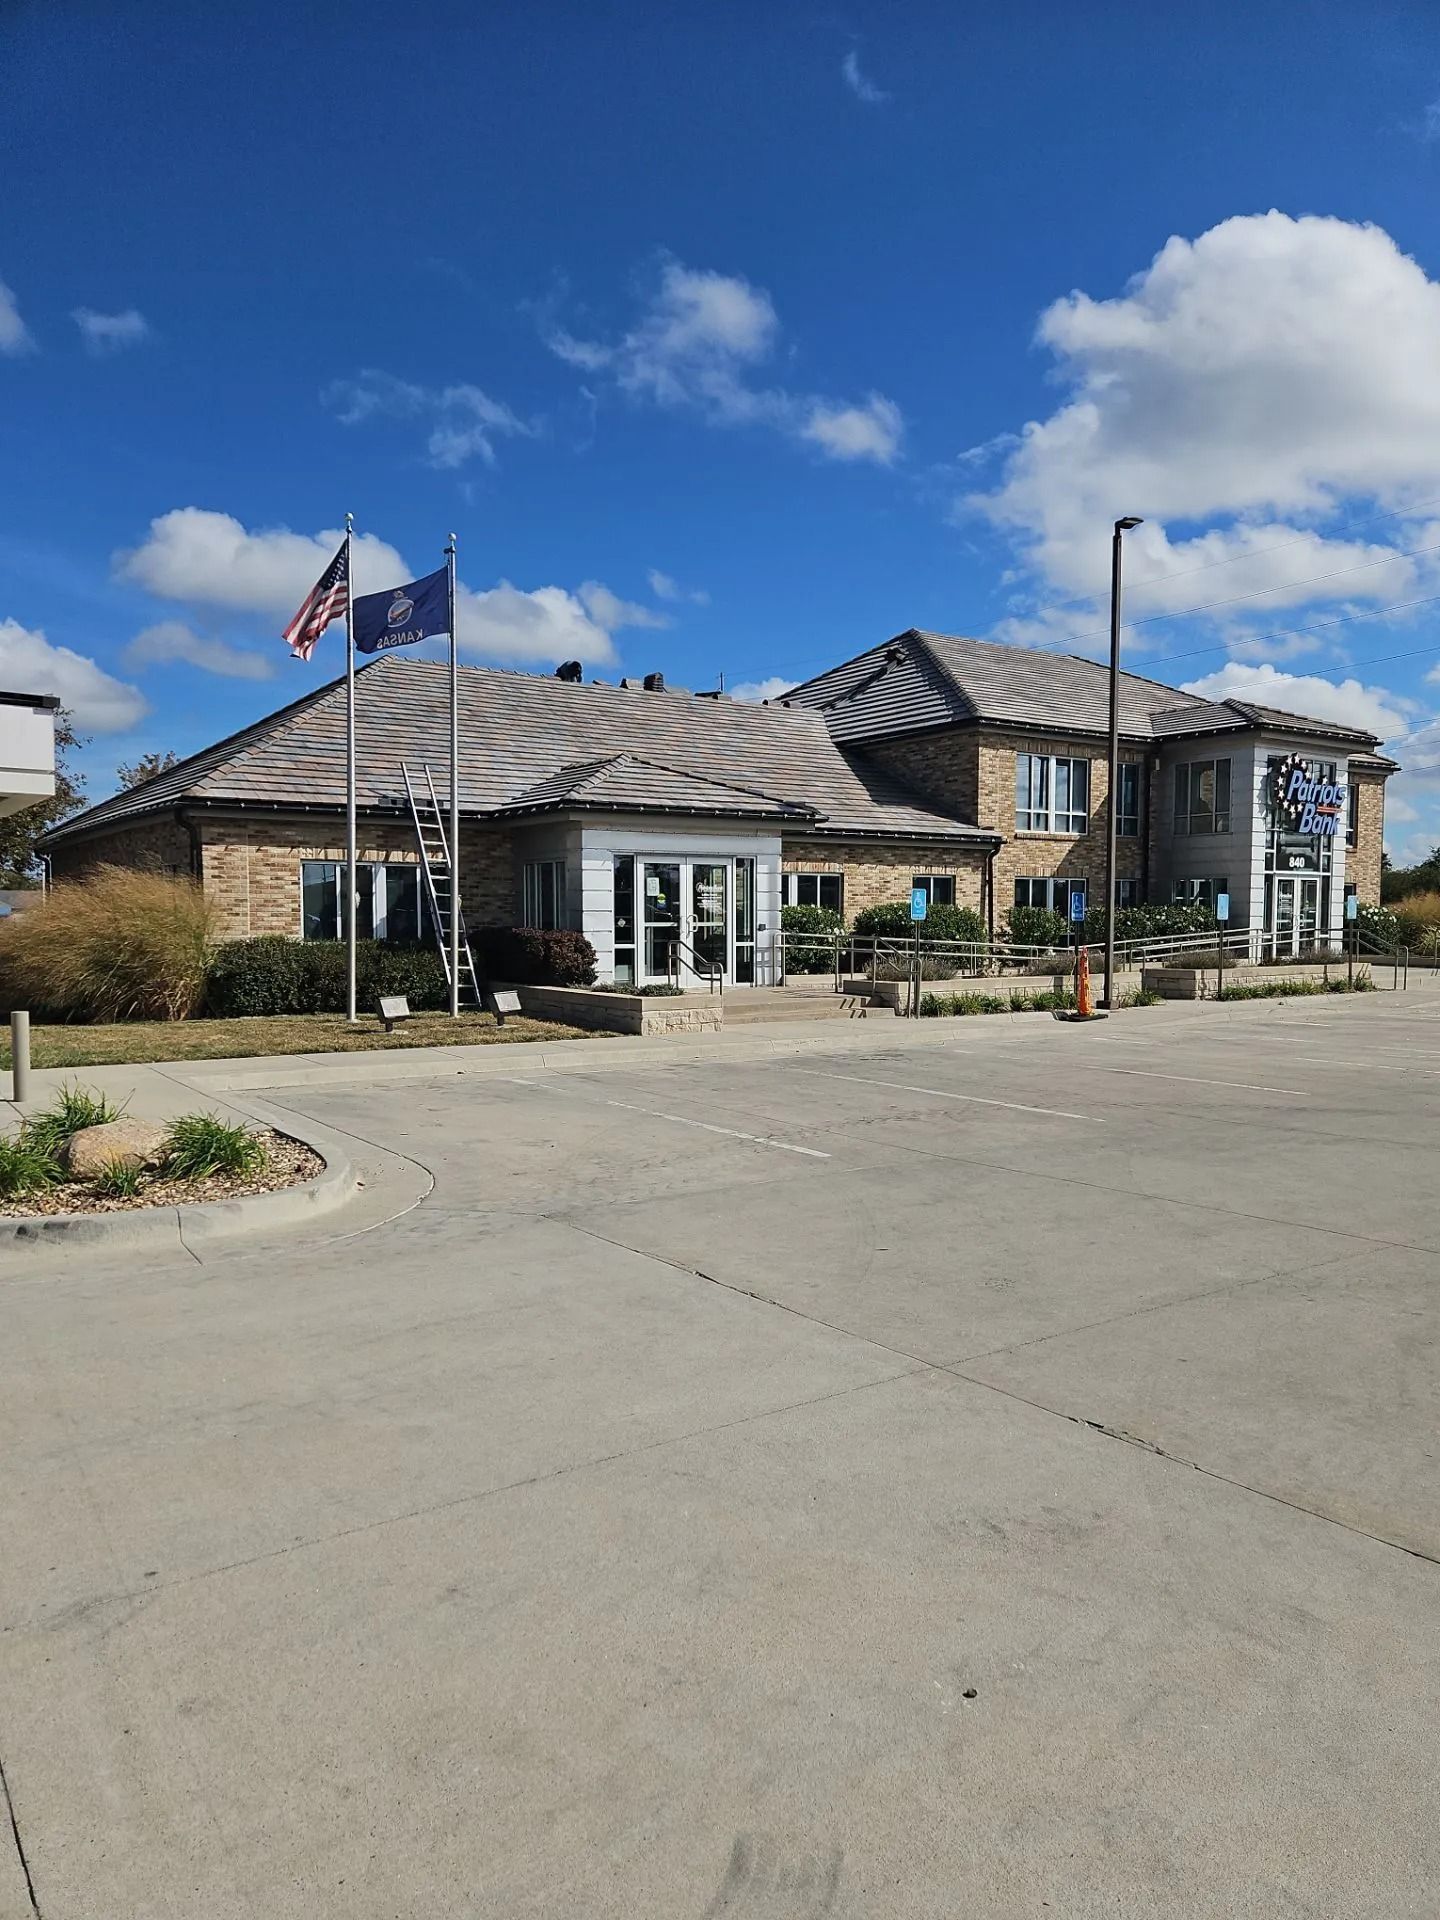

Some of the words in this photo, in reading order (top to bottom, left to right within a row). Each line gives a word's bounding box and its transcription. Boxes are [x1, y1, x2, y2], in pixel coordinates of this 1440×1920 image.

[1287, 769, 1347, 804] Patriots
[1299, 803, 1341, 835] Bank
[1288, 856, 1305, 868] 840
